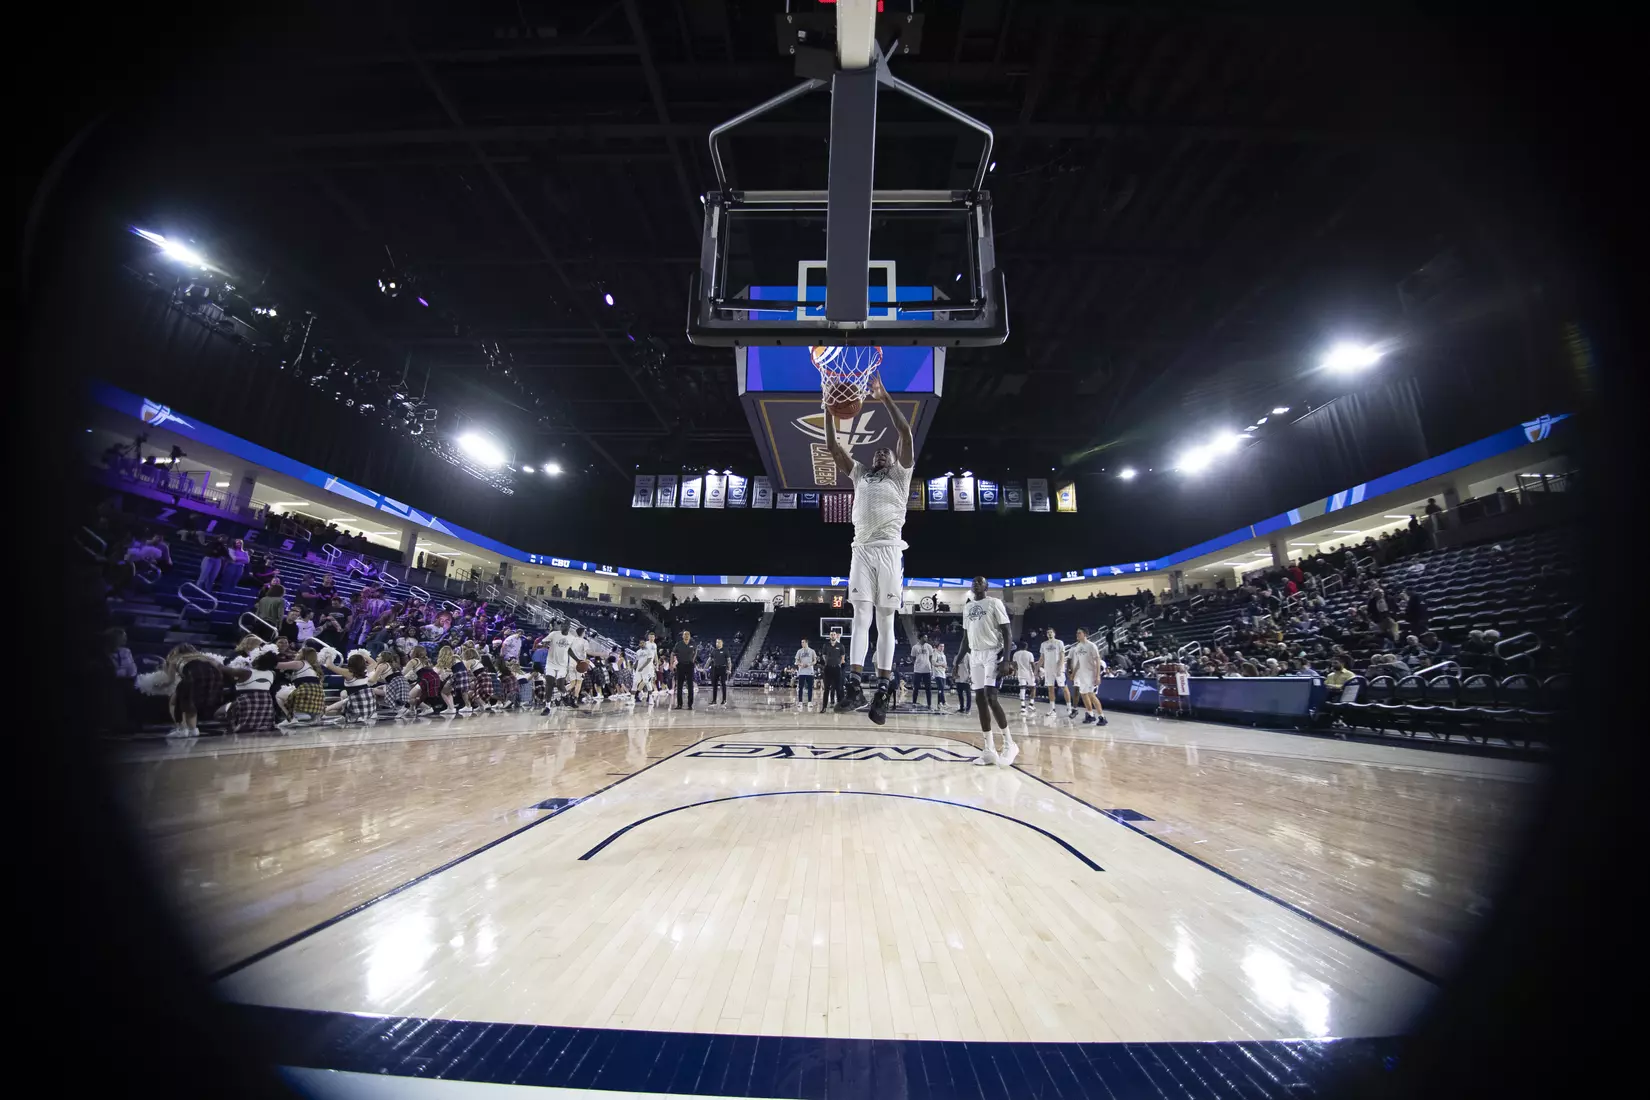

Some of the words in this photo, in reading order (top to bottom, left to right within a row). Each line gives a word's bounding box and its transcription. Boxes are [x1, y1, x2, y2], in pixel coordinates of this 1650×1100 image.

[809, 443, 836, 486] LANCERS
[552, 558, 571, 568] CBU
[1022, 576, 1037, 585] CBU
[685, 744, 980, 763] WAC
